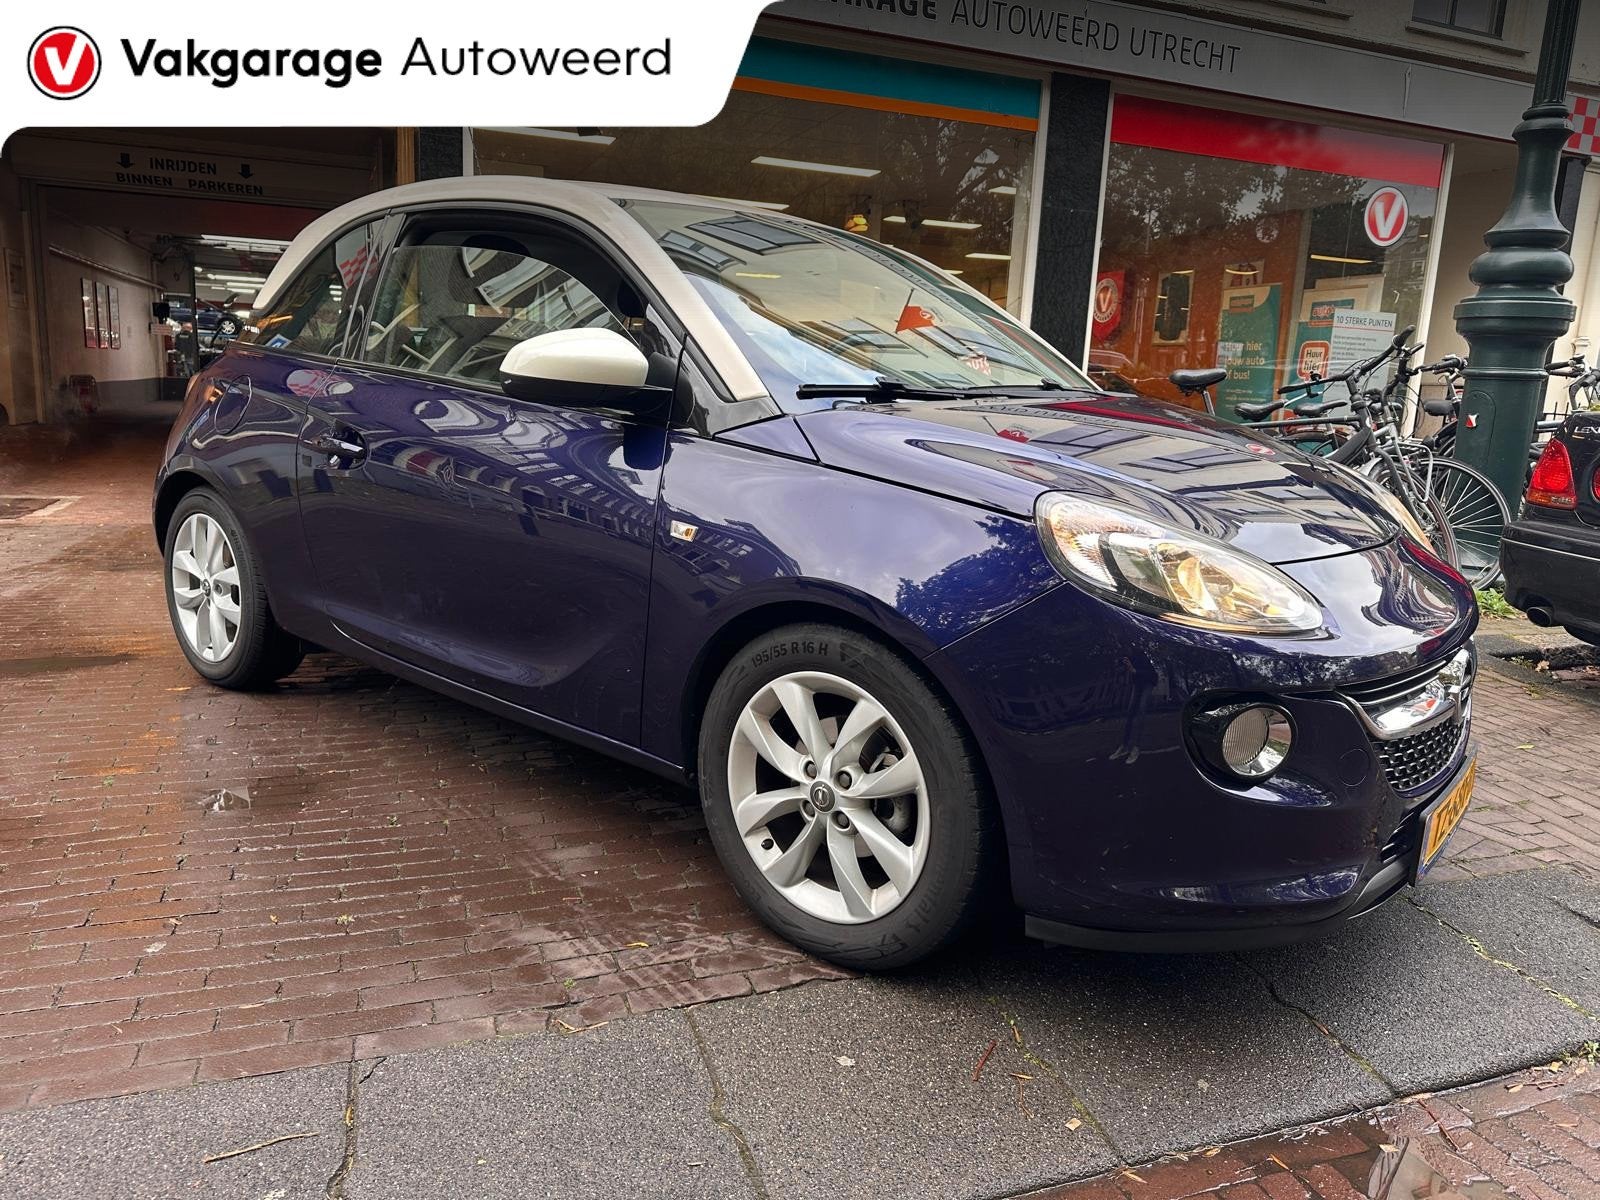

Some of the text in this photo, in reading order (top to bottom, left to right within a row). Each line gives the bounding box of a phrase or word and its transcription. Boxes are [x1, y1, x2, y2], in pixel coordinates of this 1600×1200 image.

[950, 0, 1119, 51] AUTOWEERD
[1130, 27, 1241, 73] UTRECHT
[149, 157, 217, 175] INRIJDEN
[116, 172, 264, 196] BINNEN PARKEREN
[1345, 316, 1367, 326] STERKE
[1368, 318, 1393, 328] PUNTEN
[1246, 340, 1263, 351] hier
[1306, 349, 1323, 358] Huur
[1245, 355, 1265, 366] auto
[1304, 360, 1321, 370] hier
[1233, 370, 1250, 380] bus!
[752, 643, 788, 668] 195/55
[818, 642, 829, 656] H
